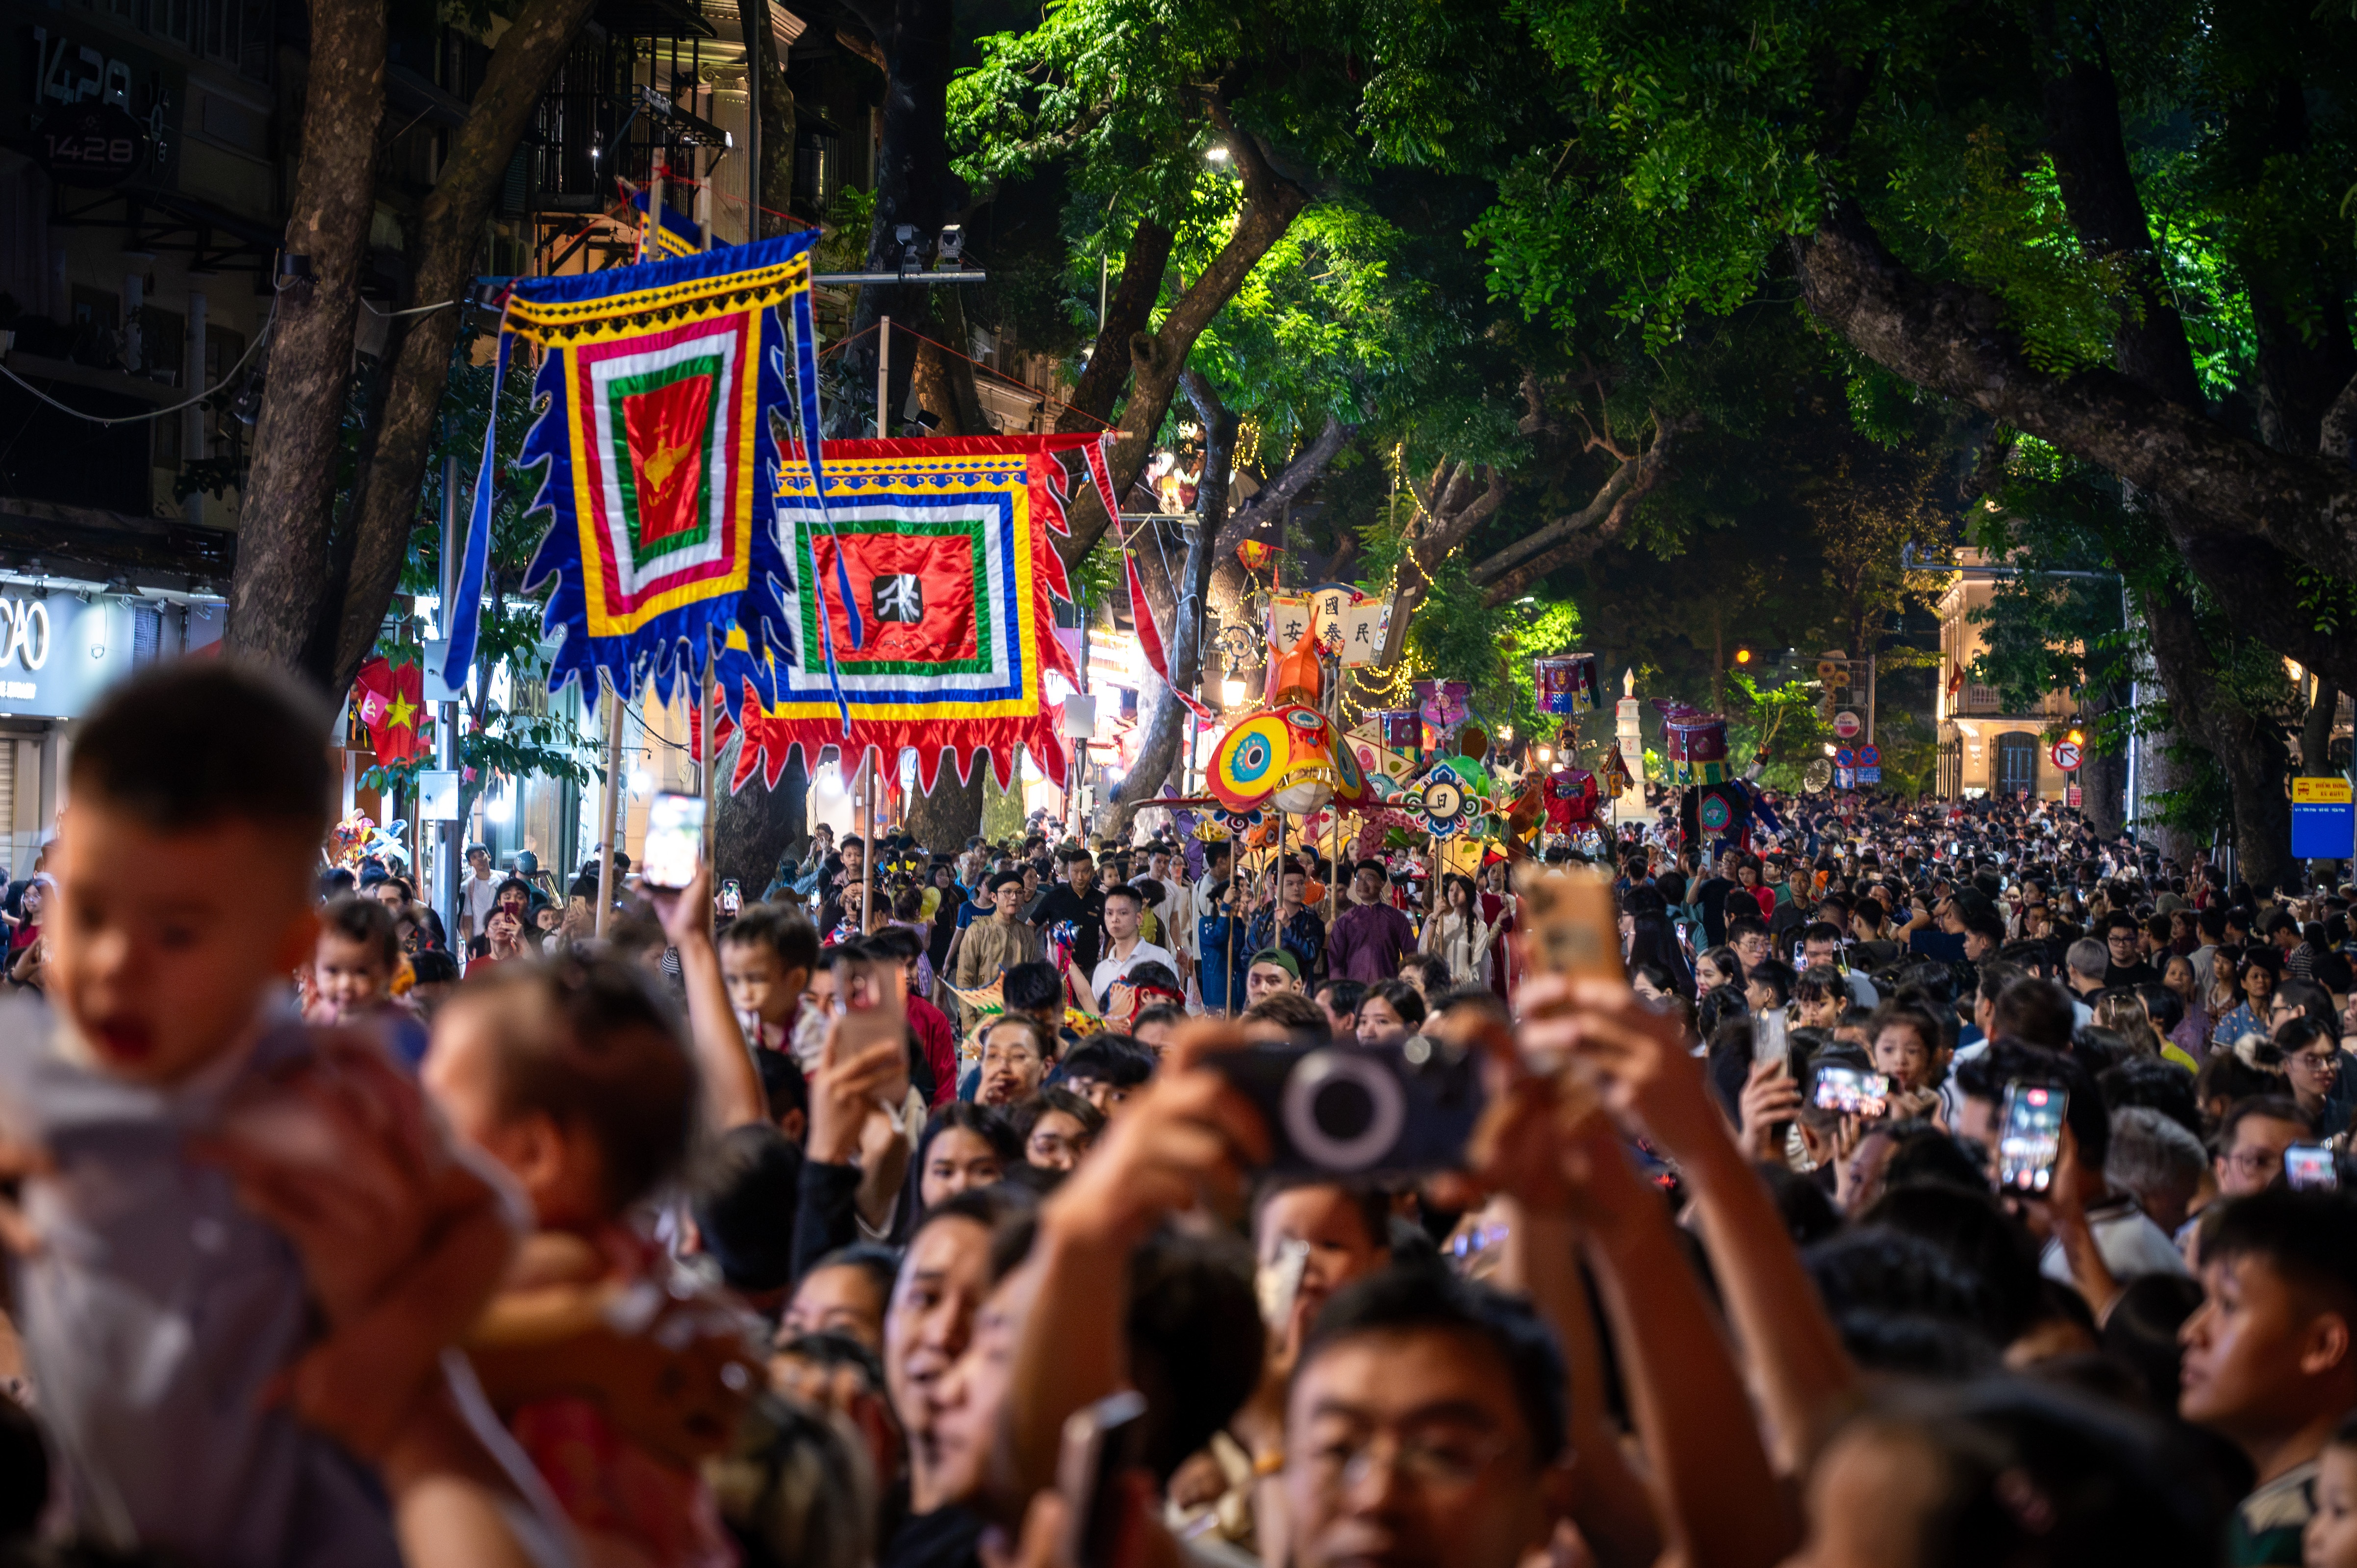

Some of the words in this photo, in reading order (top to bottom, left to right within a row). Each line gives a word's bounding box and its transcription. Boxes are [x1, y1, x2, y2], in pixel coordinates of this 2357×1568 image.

[44, 134, 133, 162] 1428
[1283, 620, 1304, 642] 安
[1355, 622, 1369, 644] 民
